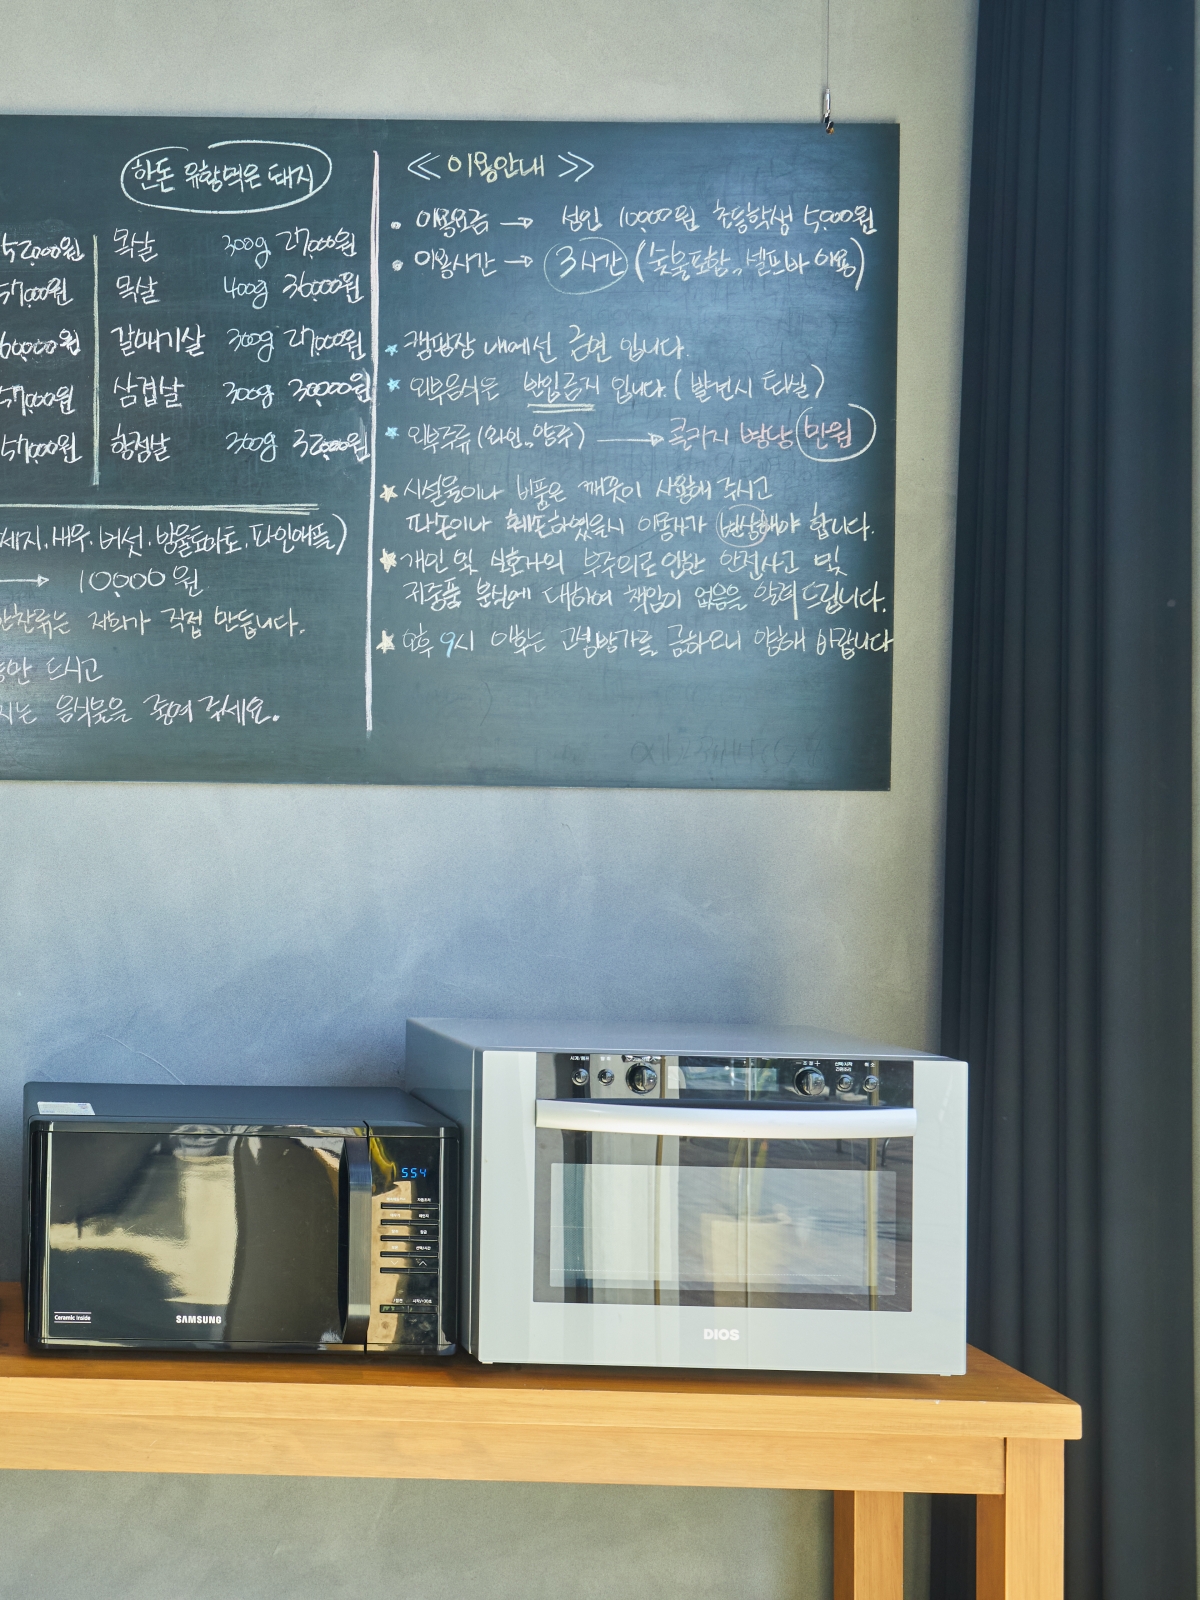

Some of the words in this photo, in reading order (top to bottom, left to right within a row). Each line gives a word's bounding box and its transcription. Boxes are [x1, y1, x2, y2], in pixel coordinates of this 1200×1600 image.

[131, 157, 175, 194] 한돈
[184, 160, 262, 193] 유황먹은
[268, 163, 314, 194] 돼지
[416, 207, 490, 238] 이용요금
[562, 205, 603, 232] 성인
[713, 198, 793, 236] 초등학생
[113, 228, 158, 263] 목살
[221, 235, 272, 270] 300g
[414, 248, 497, 280] 이용시간
[116, 275, 161, 305] 목살
[223, 275, 269, 310] 400g
[110, 323, 206, 357] 갈매기살
[226, 328, 275, 363] 300g
[403, 330, 477, 361] 캠핑장
[568, 324, 612, 363] 금연
[113, 372, 185, 408] 삼겹살
[222, 381, 275, 409] 300g
[409, 373, 500, 406] 외부음식은
[523, 371, 600, 404] 반입금지
[110, 422, 171, 463] 항정살
[226, 431, 279, 463] 300g
[407, 422, 471, 456] 외부주류
[740, 421, 794, 450] 병당
[804, 414, 852, 450] 만원
[516, 474, 567, 511] 비품은
[577, 475, 643, 504] 깨끗이
[656, 473, 712, 505] 사용해
[716, 475, 775, 501] 주시고
[405, 512, 493, 541] 파손이나
[719, 508, 801, 541] 변상해야
[400, 548, 449, 574] 개인
[453, 548, 479, 576] 및
[583, 547, 657, 578] 부주의로
[660, 550, 707, 580] 인한
[719, 549, 800, 581] 안전사고
[814, 545, 848, 576] 및
[402, 576, 462, 612] 귀중품
[476, 577, 532, 610] 분실에
[542, 581, 614, 612] 대하여
[623, 584, 682, 615] 책임이
[694, 582, 749, 612] 없음을
[88, 609, 152, 636] 저희가
[160, 607, 202, 639] 직접
[402, 622, 434, 659] 오후
[439, 630, 474, 658] 9시
[490, 624, 546, 657] 이후는
[560, 625, 659, 659] 고성방가를
[667, 624, 742, 658] 금하오니
[753, 624, 806, 657] 양해
[816, 628, 895, 661] 바랍니다
[46, 655, 104, 684] 드시고
[55, 694, 134, 728] 음식물을
[175, 1315, 222, 1324] SAMSUNG
[703, 1328, 740, 1341] DIOS
